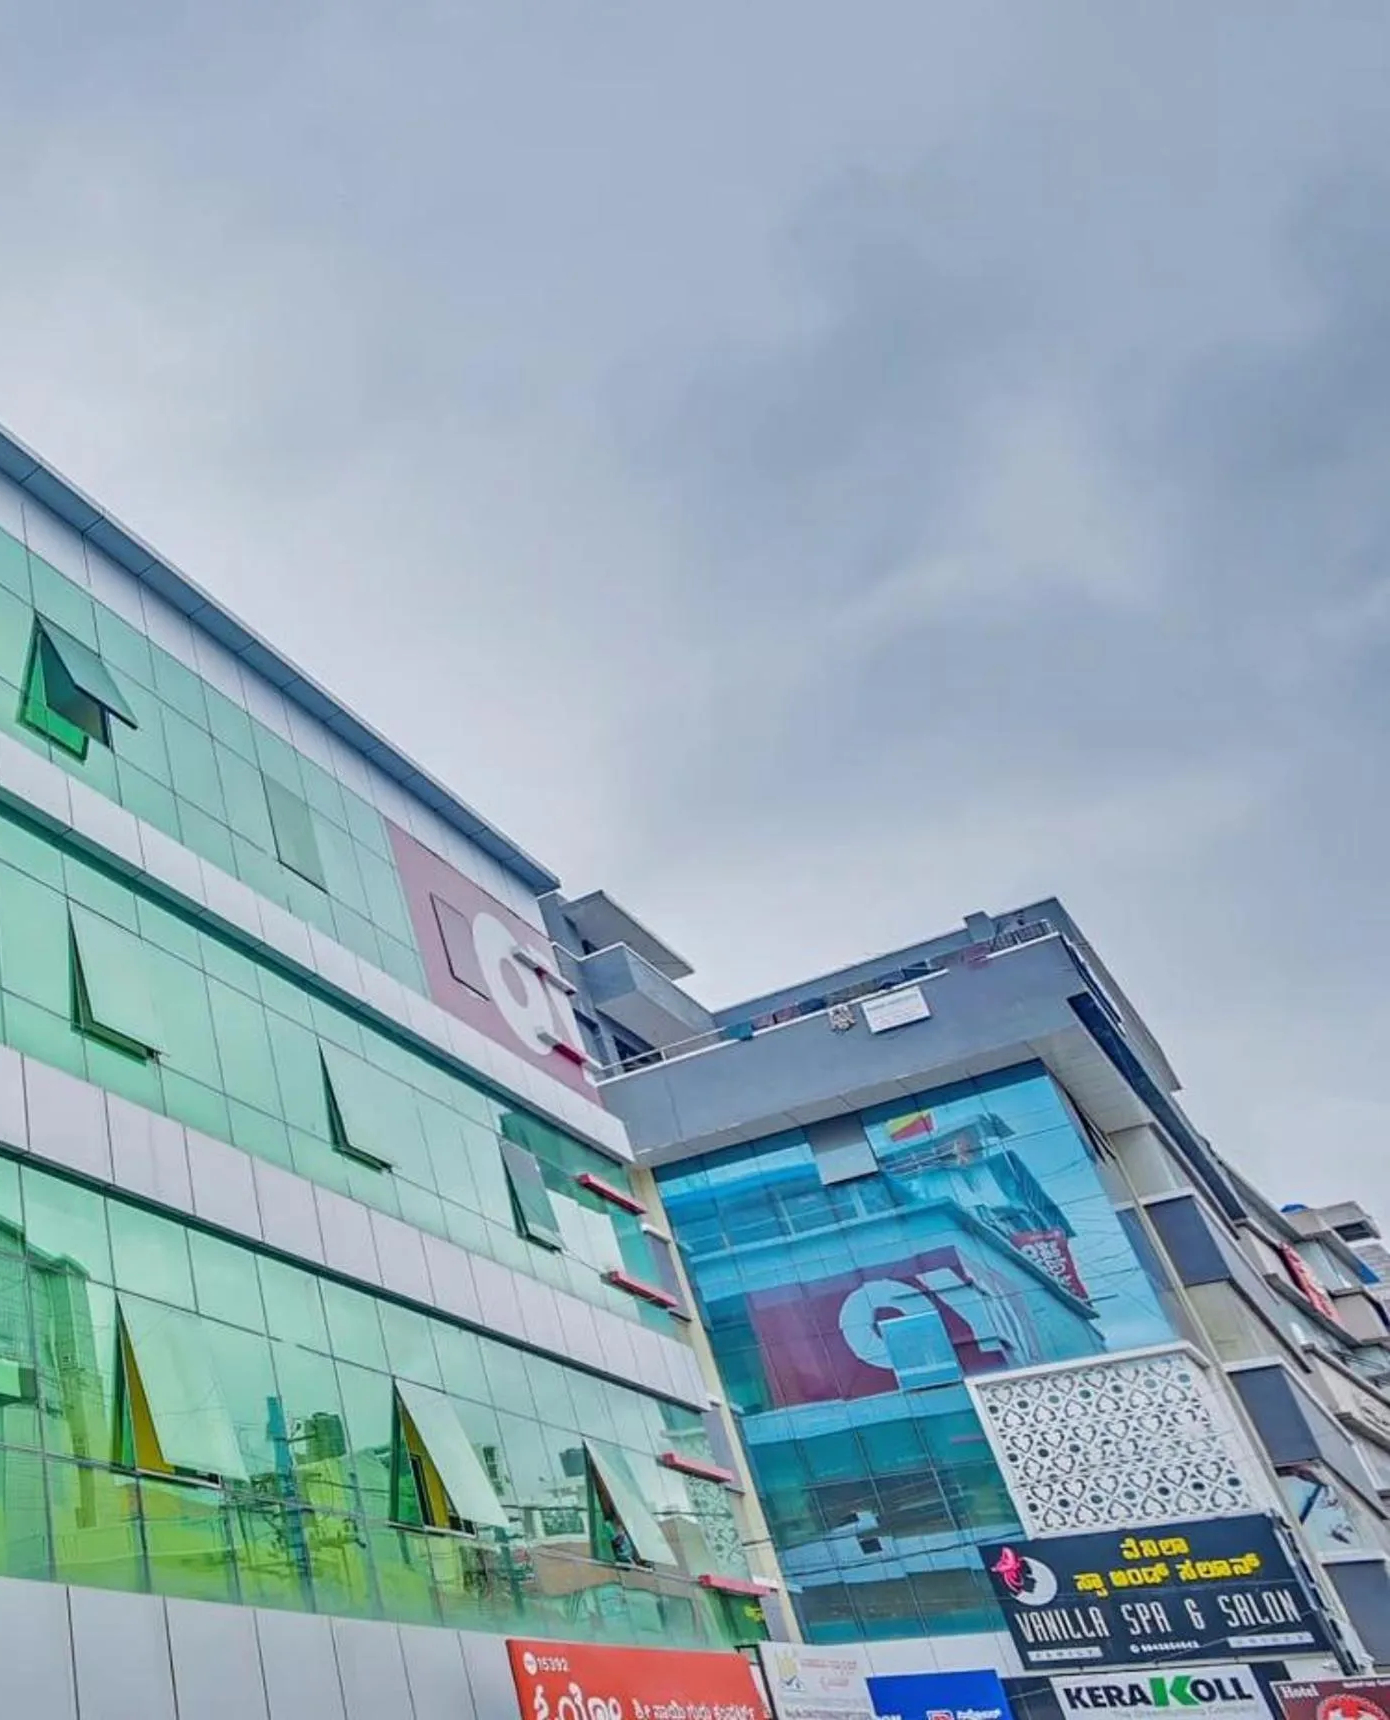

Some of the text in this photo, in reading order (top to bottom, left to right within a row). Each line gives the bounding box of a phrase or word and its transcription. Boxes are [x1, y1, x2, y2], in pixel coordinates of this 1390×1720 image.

[1014, 1602, 1110, 1644] VANILLA
[1122, 1599, 1172, 1636] SPA
[1217, 1589, 1303, 1628] SALON
[1062, 1674, 1254, 1710] KERAKOLL
[1279, 1684, 1319, 1699] Hotel
